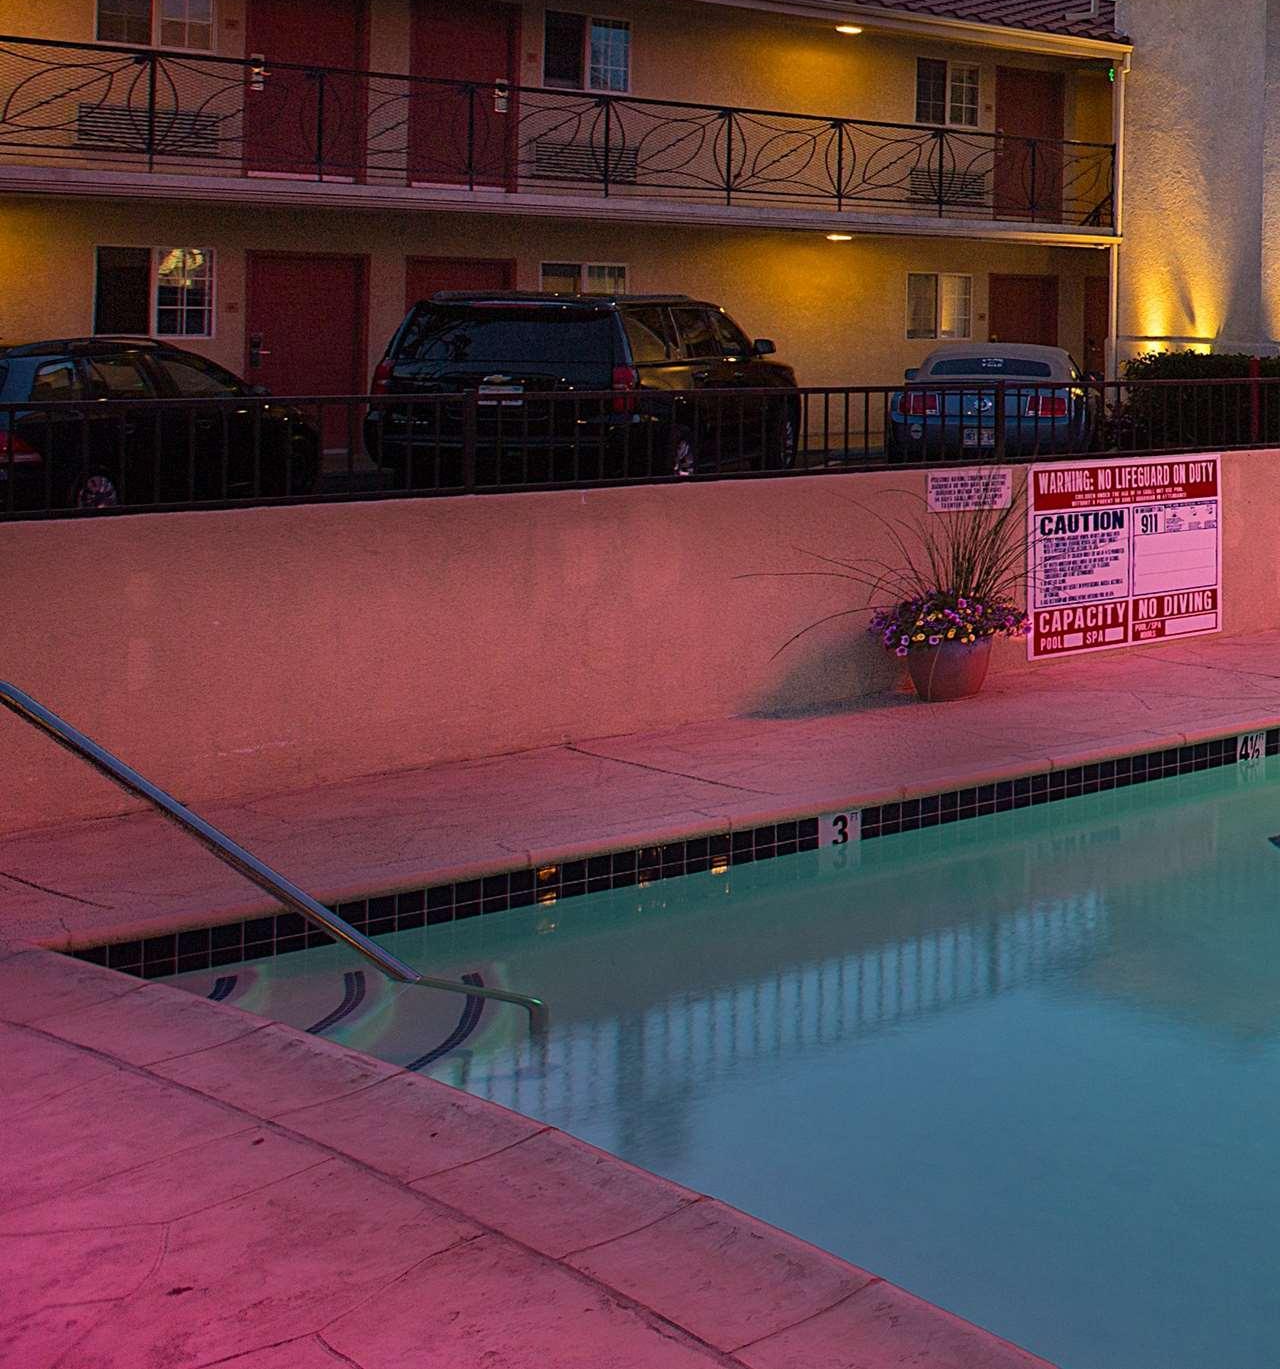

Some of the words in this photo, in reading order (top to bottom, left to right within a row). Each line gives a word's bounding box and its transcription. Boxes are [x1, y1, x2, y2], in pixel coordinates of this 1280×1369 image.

[1039, 470, 1094, 495] WARNING:
[1098, 469, 1111, 490] NO
[1115, 465, 1170, 489] LIFEGUARD
[1173, 463, 1186, 484] ON
[1189, 462, 1213, 484] DUTY
[1040, 510, 1124, 536] CAUTION
[1141, 513, 1157, 533] 911
[1040, 602, 1126, 633] CAPACITY
[1138, 598, 1157, 620] NO
[1164, 591, 1212, 616] DIVING
[1041, 635, 1062, 651] POOL
[1086, 630, 1103, 644] SPA
[832, 815, 848, 845] 3
